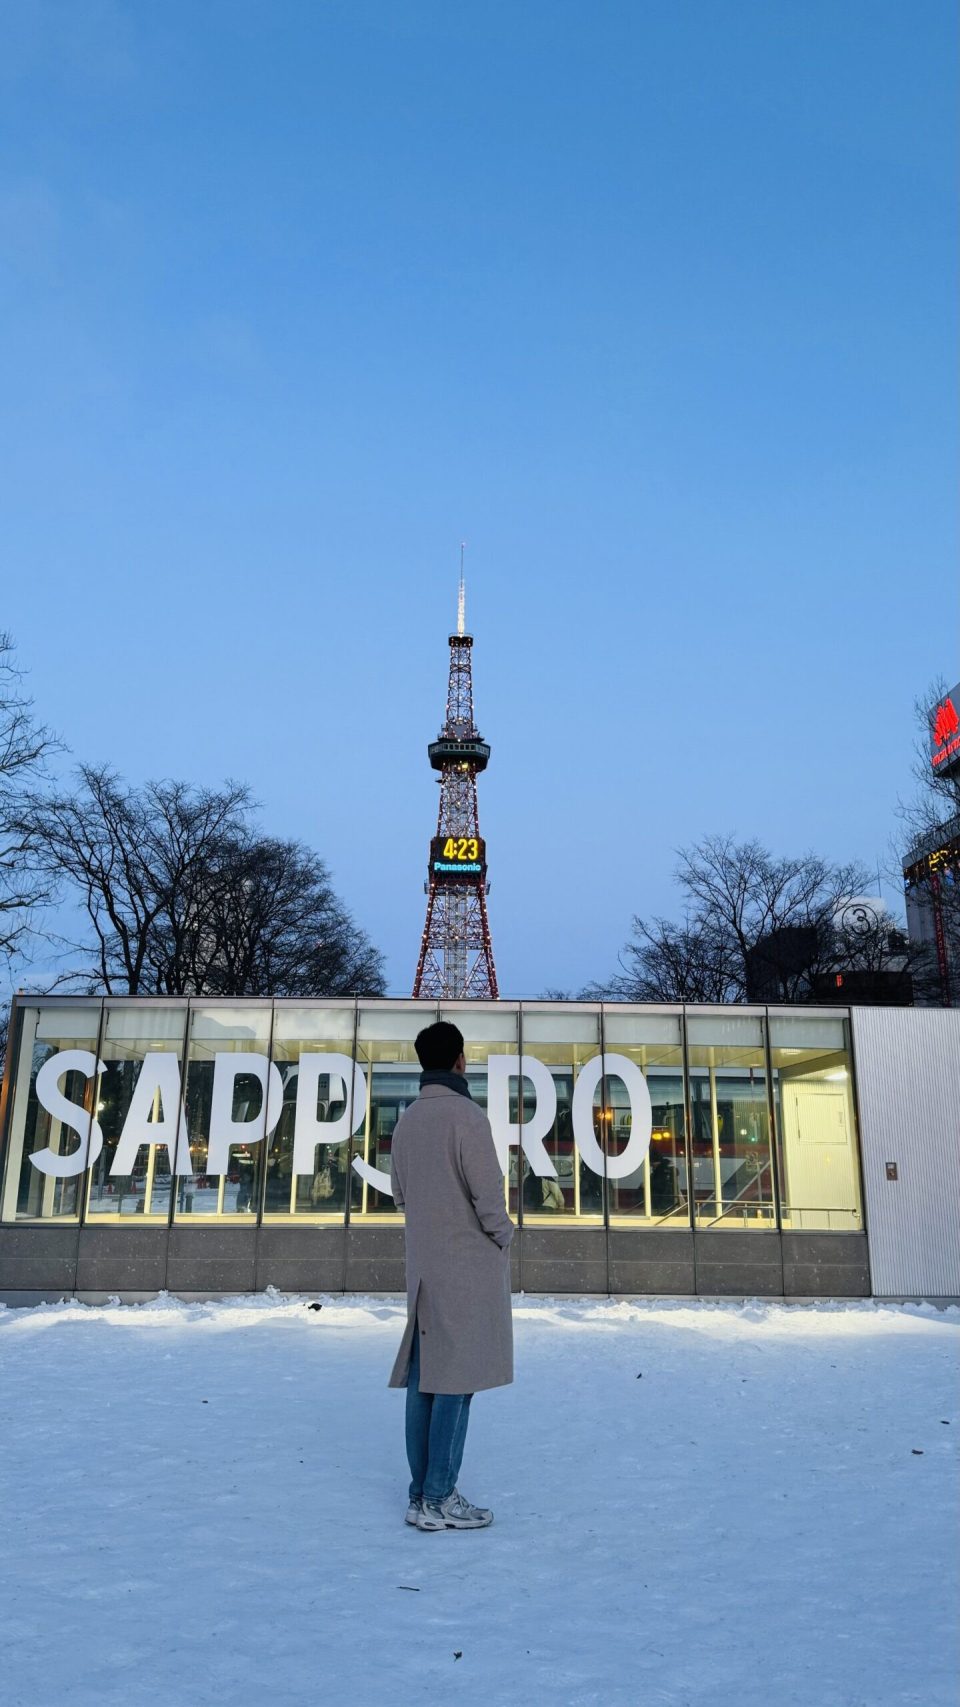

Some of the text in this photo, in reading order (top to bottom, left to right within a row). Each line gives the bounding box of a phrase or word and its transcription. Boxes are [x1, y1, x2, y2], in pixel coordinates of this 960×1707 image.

[443, 838, 478, 860] 4:23
[434, 862, 481, 871] Panasonic
[28, 1049, 651, 1197] SAPPRO
